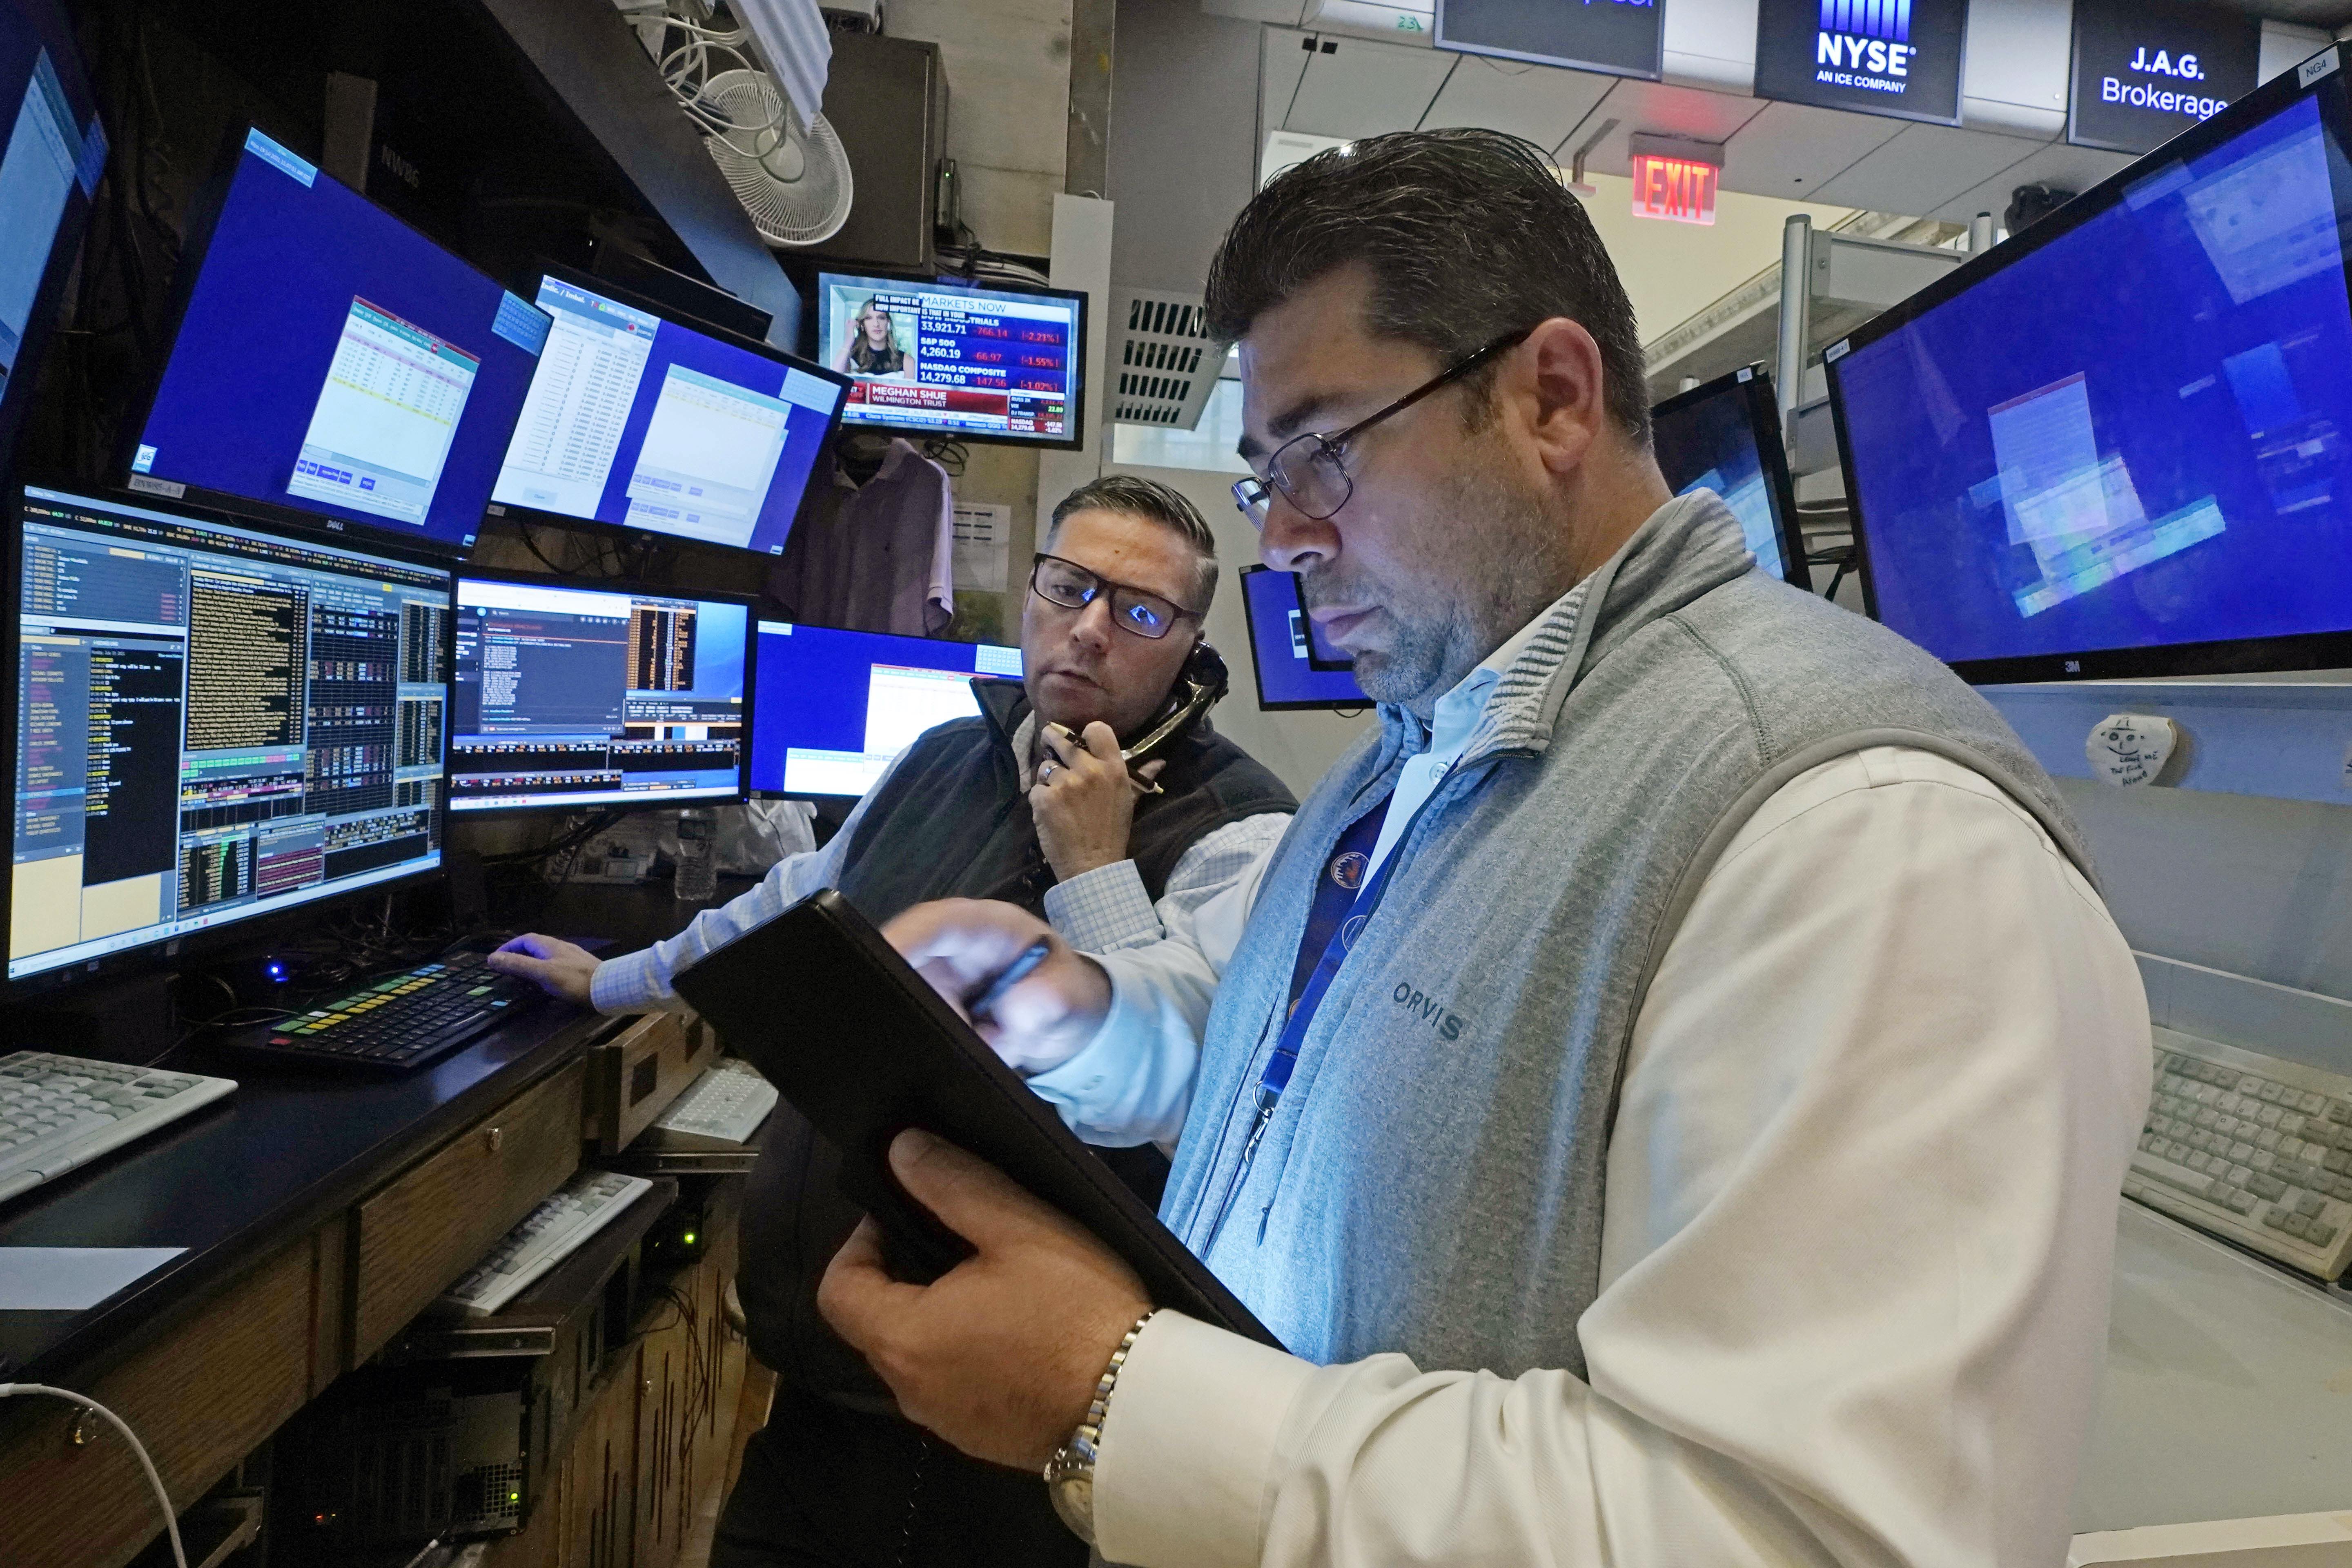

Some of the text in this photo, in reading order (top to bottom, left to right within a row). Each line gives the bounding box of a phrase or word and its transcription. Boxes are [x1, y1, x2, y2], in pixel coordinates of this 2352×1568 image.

[1817, 32, 1908, 76] NYSE
[2130, 47, 2205, 80] J.A.G.
[2306, 59, 2326, 77] NG4
[1817, 70, 1906, 93] AN ICE COMPANY
[1646, 160, 1709, 219] EXIT
[890, 296, 911, 305] IMPACT
[922, 296, 1006, 313] MARKETS NOW
[889, 305, 920, 314] IMPORTANT
[921, 321, 967, 334] 33,921.71
[920, 337, 956, 347] S&P 500
[920, 346, 961, 359] 4,260.19
[920, 363, 1006, 377] NASDAQ COMPOSITE
[920, 372, 966, 384] 14,279.68
[872, 386, 947, 400] MEGHAN SHUE
[872, 395, 921, 405] WILMINGTON
[924, 399, 947, 407] TRUST
[2065, 660, 2080, 672] 3M
[1394, 982, 1463, 1040] ORVIS
